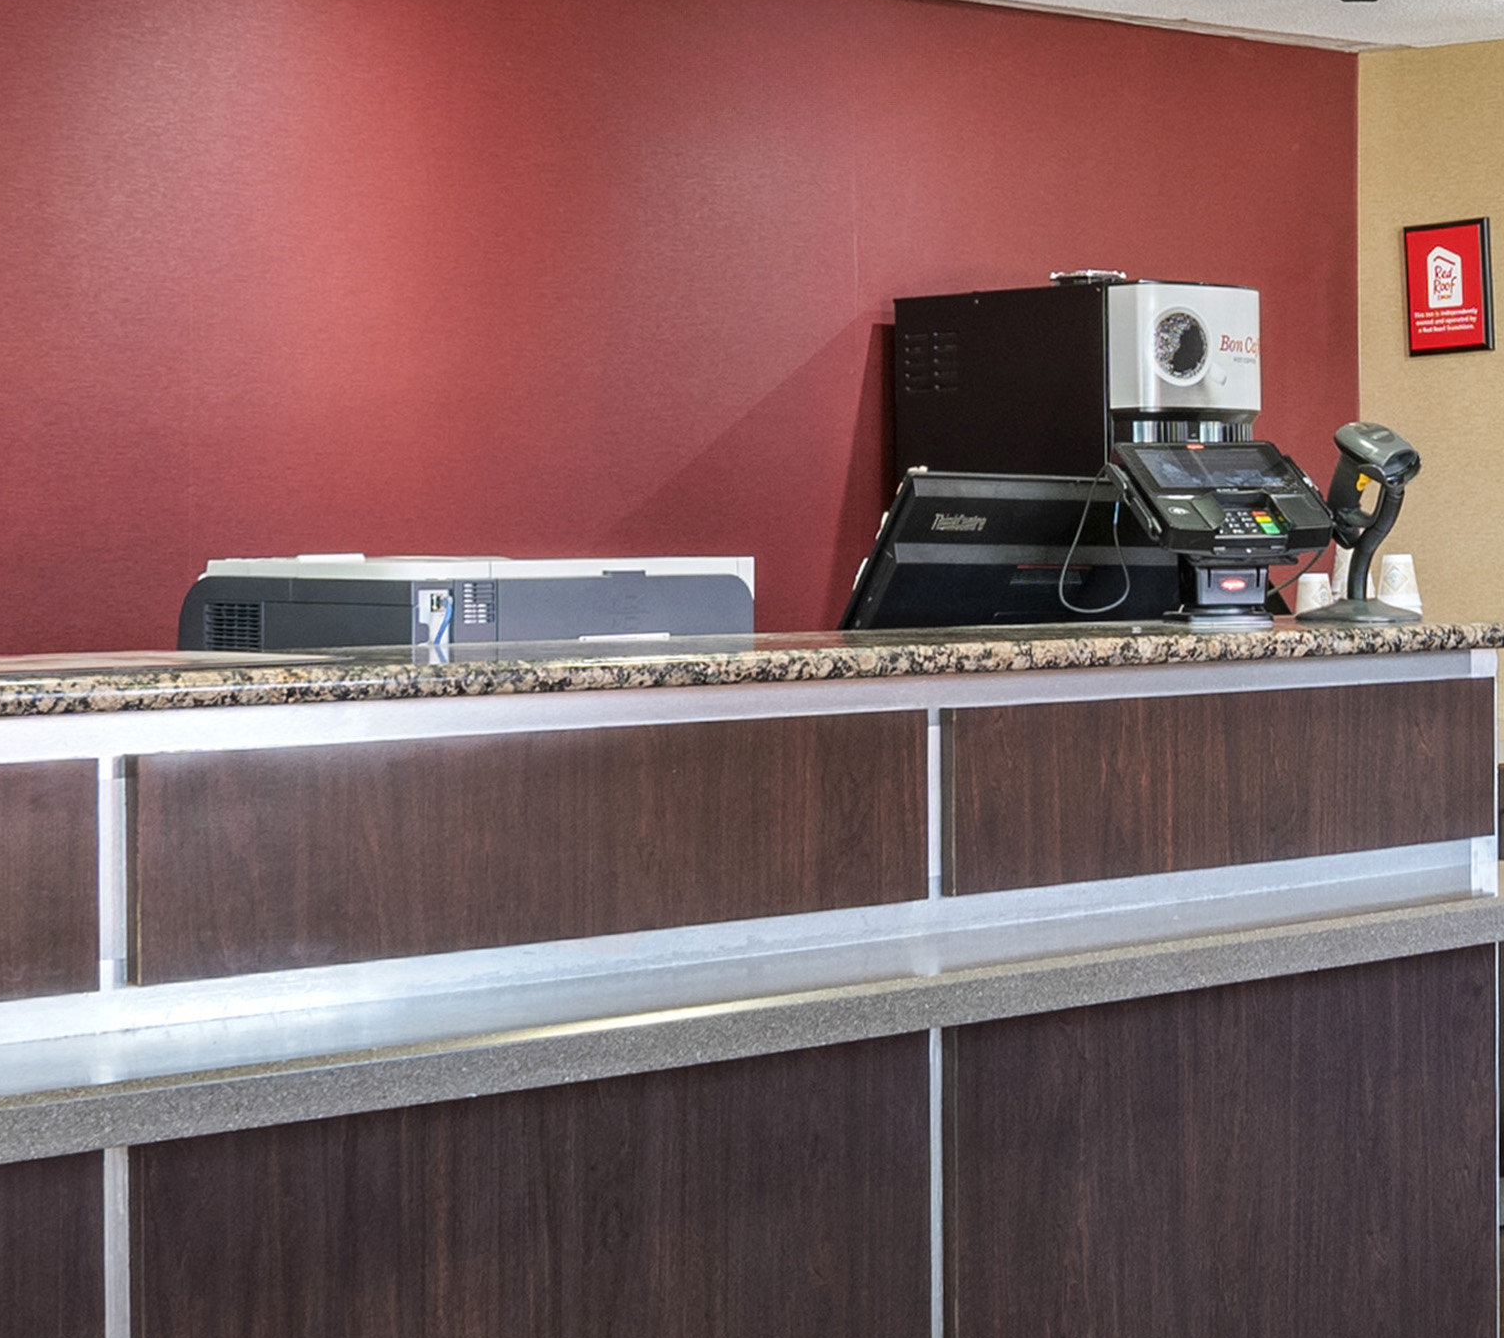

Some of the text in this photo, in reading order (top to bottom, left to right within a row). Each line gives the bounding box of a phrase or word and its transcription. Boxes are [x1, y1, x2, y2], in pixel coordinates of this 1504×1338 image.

[1434, 266, 1453, 279] Red
[1434, 276, 1457, 295] Roof
[1220, 335, 1243, 353] Bon
